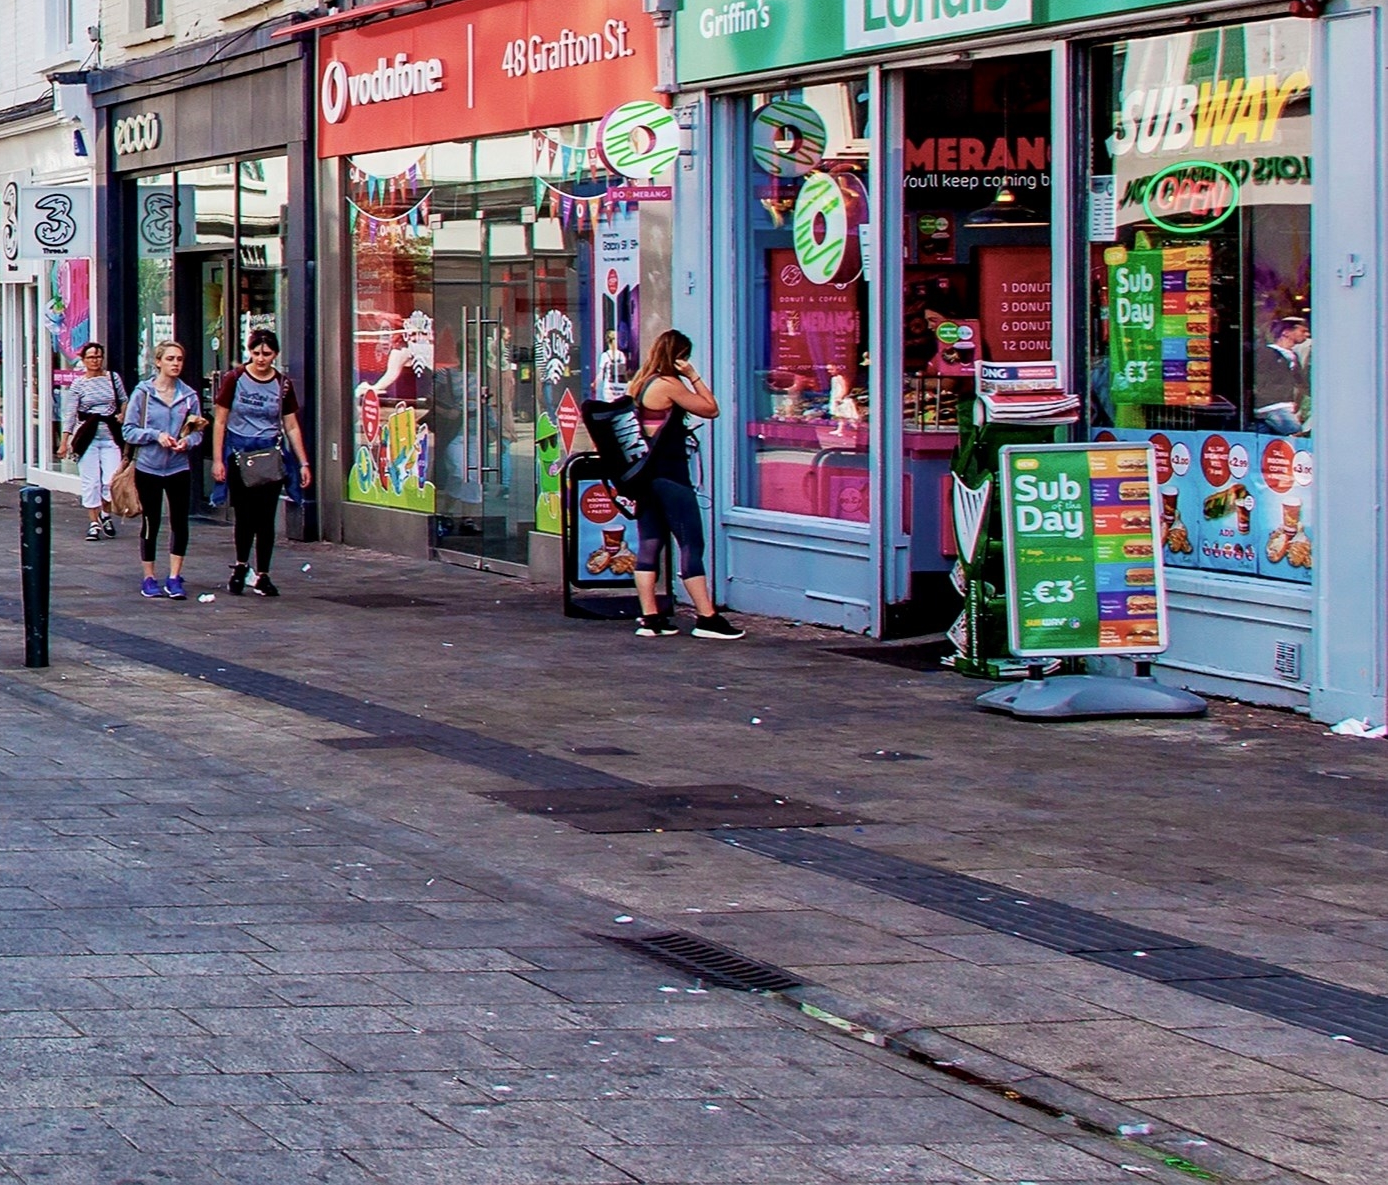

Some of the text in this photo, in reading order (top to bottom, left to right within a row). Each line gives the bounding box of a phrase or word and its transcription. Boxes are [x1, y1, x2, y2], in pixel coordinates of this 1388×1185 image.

[346, 18, 635, 107] vodafone 48 Grafton St.
[1106, 70, 1311, 158] SUBWAY
[114, 112, 159, 156] ecco
[942, 173, 980, 191] keep
[1156, 176, 1228, 217] OPEN
[34, 193, 77, 247] 3
[1001, 282, 1052, 293] 1 DONUT
[1115, 265, 1154, 294] Sub
[1000, 301, 1052, 312] 3 DONUT
[1116, 297, 1155, 330] Day
[1001, 321, 1052, 332] 6 DONUT
[1002, 340, 1016, 351] 12
[981, 367, 1008, 379] DNG
[1125, 359, 1148, 383] €3
[611, 410, 650, 464] NIKE
[1014, 472, 1082, 503] Sub
[1016, 504, 1085, 539] Day
[1032, 579, 1075, 604] €3
